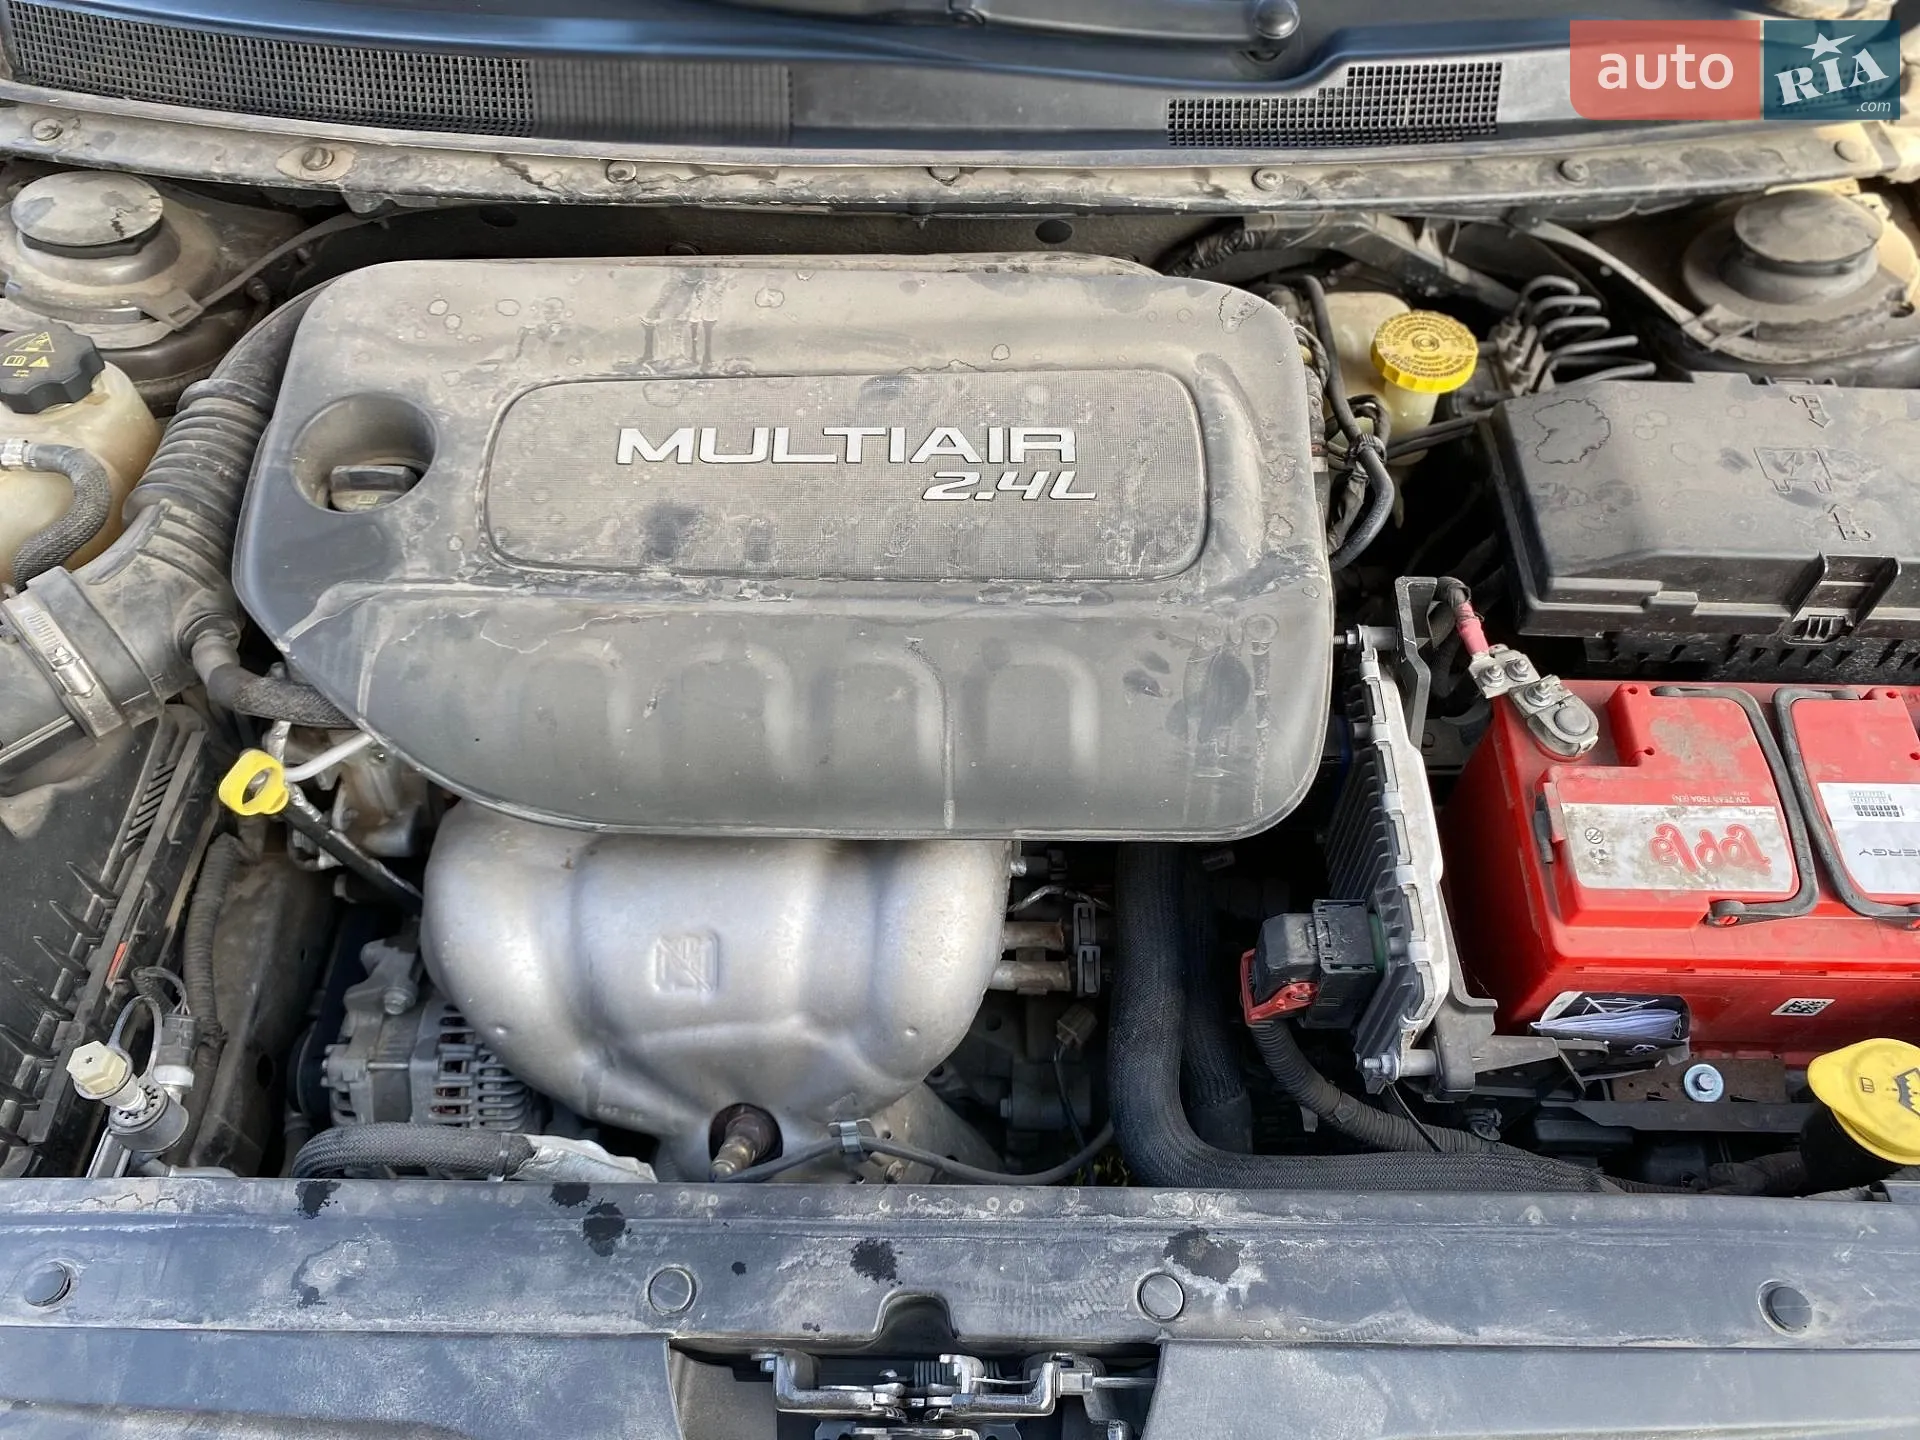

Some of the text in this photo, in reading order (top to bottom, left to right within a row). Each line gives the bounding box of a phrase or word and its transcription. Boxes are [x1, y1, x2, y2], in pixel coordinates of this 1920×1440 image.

[616, 427, 1076, 464] MULTIAIR
[921, 471, 1097, 501] 2.4L
[1859, 847, 1920, 857] ERGY
